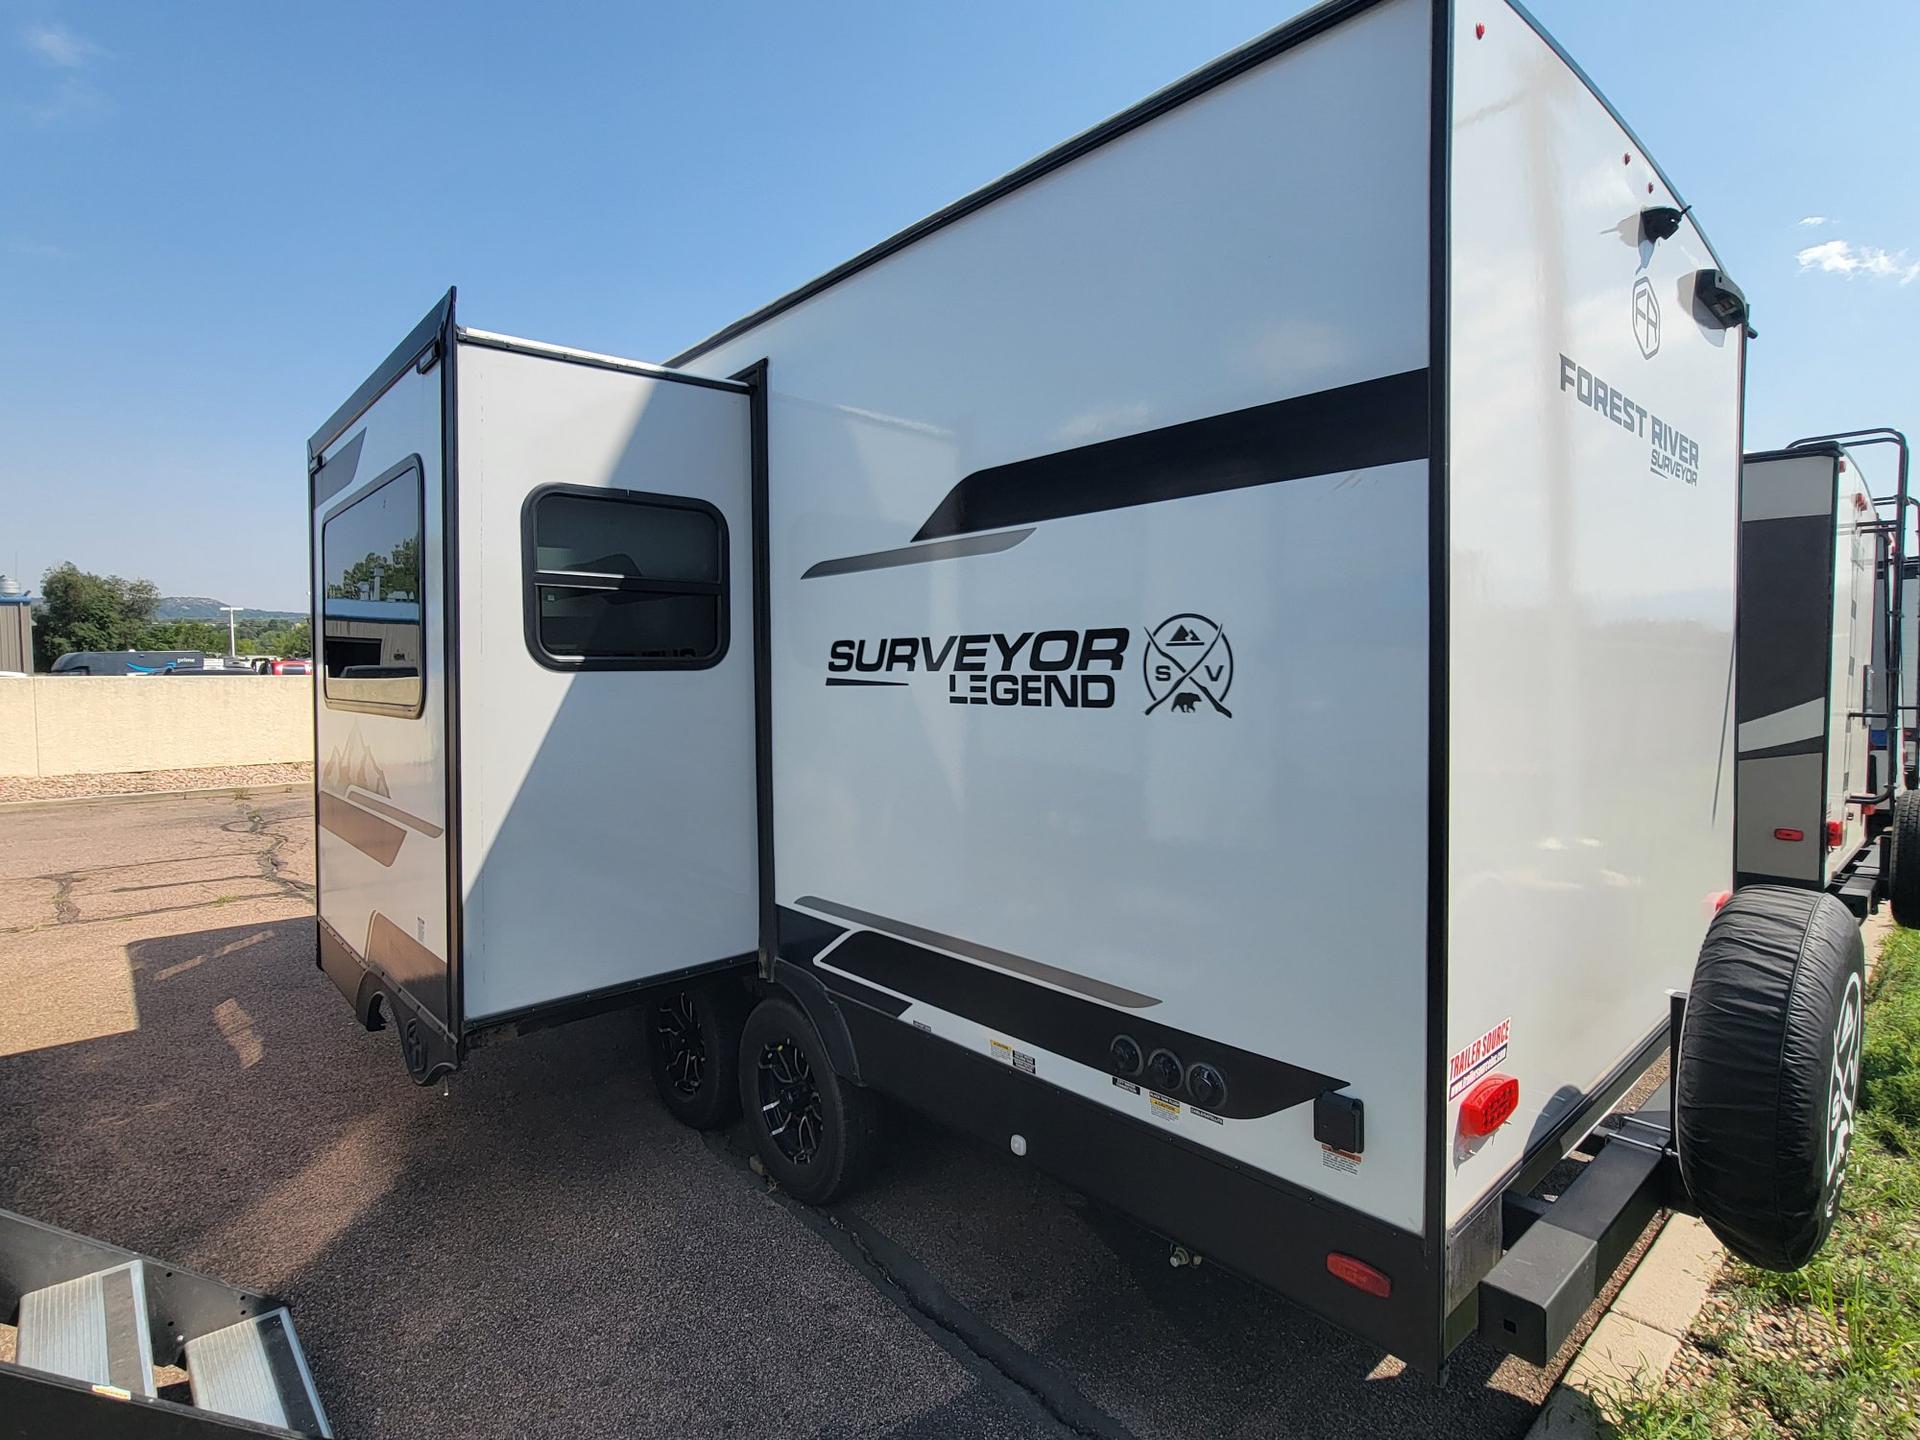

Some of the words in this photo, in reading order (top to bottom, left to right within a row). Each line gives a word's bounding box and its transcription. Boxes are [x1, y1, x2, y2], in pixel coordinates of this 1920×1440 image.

[1559, 352, 1648, 438] FOREST
[1650, 414, 1699, 469] RIVER
[1650, 449, 1698, 486] SURVEYOR
[828, 627, 1130, 672] SURVEYOR
[949, 674, 1116, 708] LEGEND
[1449, 1039, 1482, 1081] TRAILER
[1481, 1019, 1510, 1057] SOURCE
